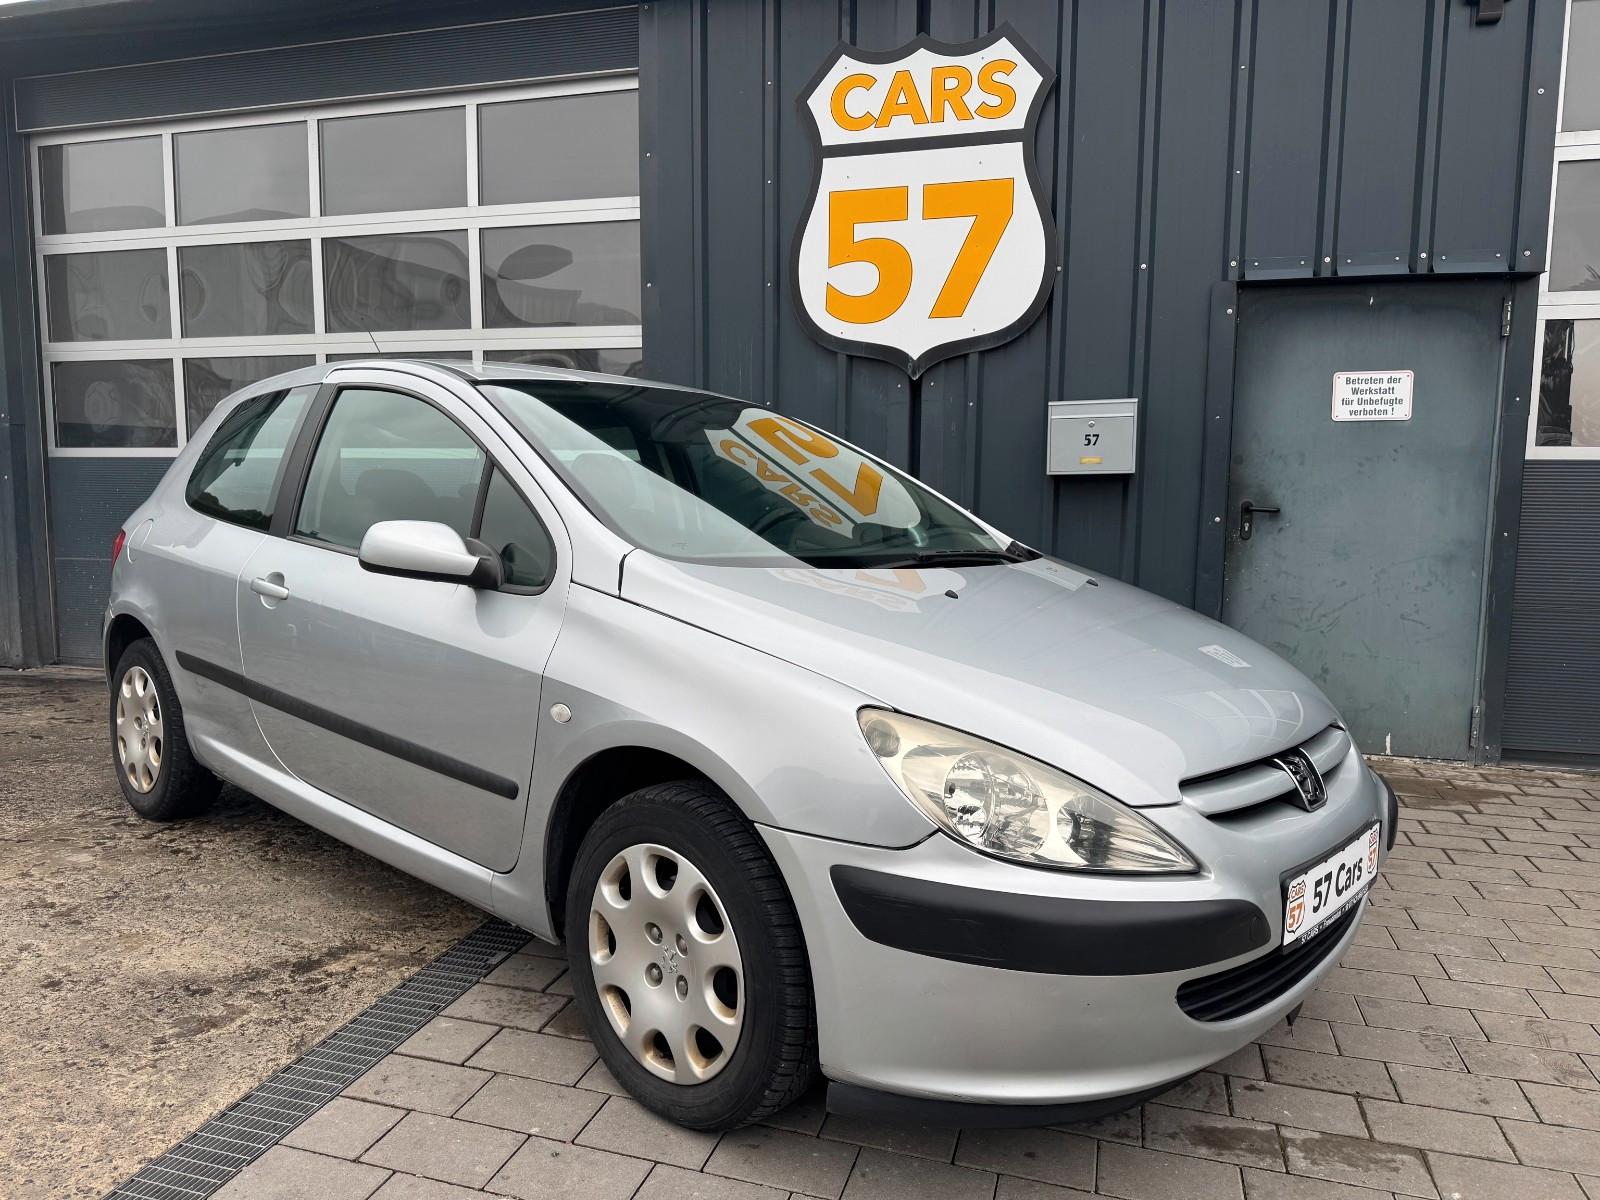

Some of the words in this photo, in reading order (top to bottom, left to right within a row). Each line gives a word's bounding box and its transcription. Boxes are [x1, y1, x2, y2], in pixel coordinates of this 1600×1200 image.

[830, 59, 1017, 131] CARS
[825, 177, 1014, 324] 57
[1345, 376, 1384, 385] Betreten
[1386, 375, 1402, 384] der
[1351, 386, 1395, 396] Werkstatt
[1341, 397, 1354, 406] für
[1357, 396, 1404, 407] Unbefugte
[1348, 408, 1388, 416] verboten
[1083, 433, 1100, 446] 57
[1312, 870, 1333, 913] 57
[1335, 857, 1363, 897] Cars
[1287, 902, 1303, 929] 57
